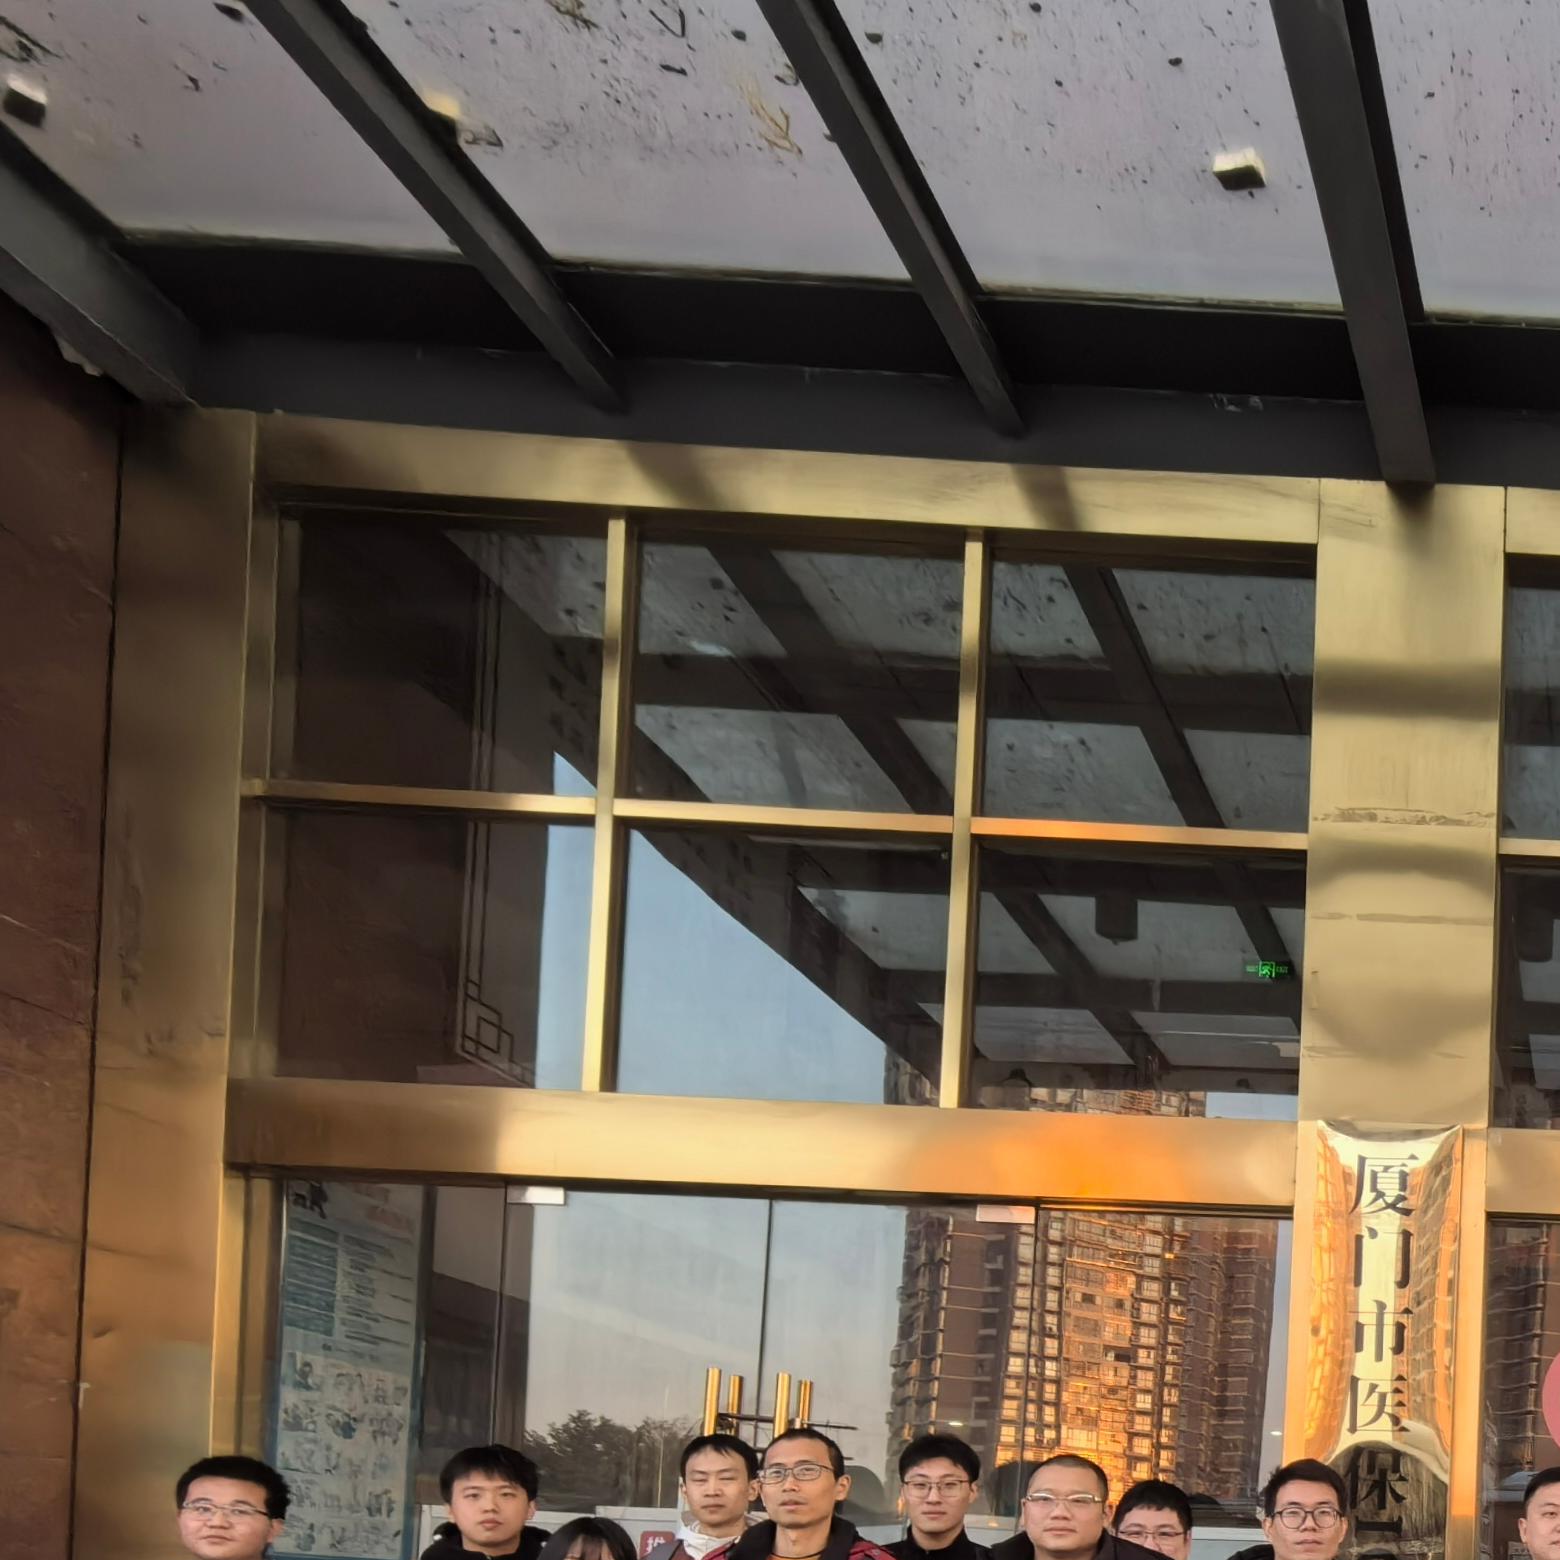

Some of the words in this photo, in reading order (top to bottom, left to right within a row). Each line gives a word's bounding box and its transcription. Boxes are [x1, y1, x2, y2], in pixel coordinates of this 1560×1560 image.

[1345, 1152, 1419, 1540] 厦门市医保
